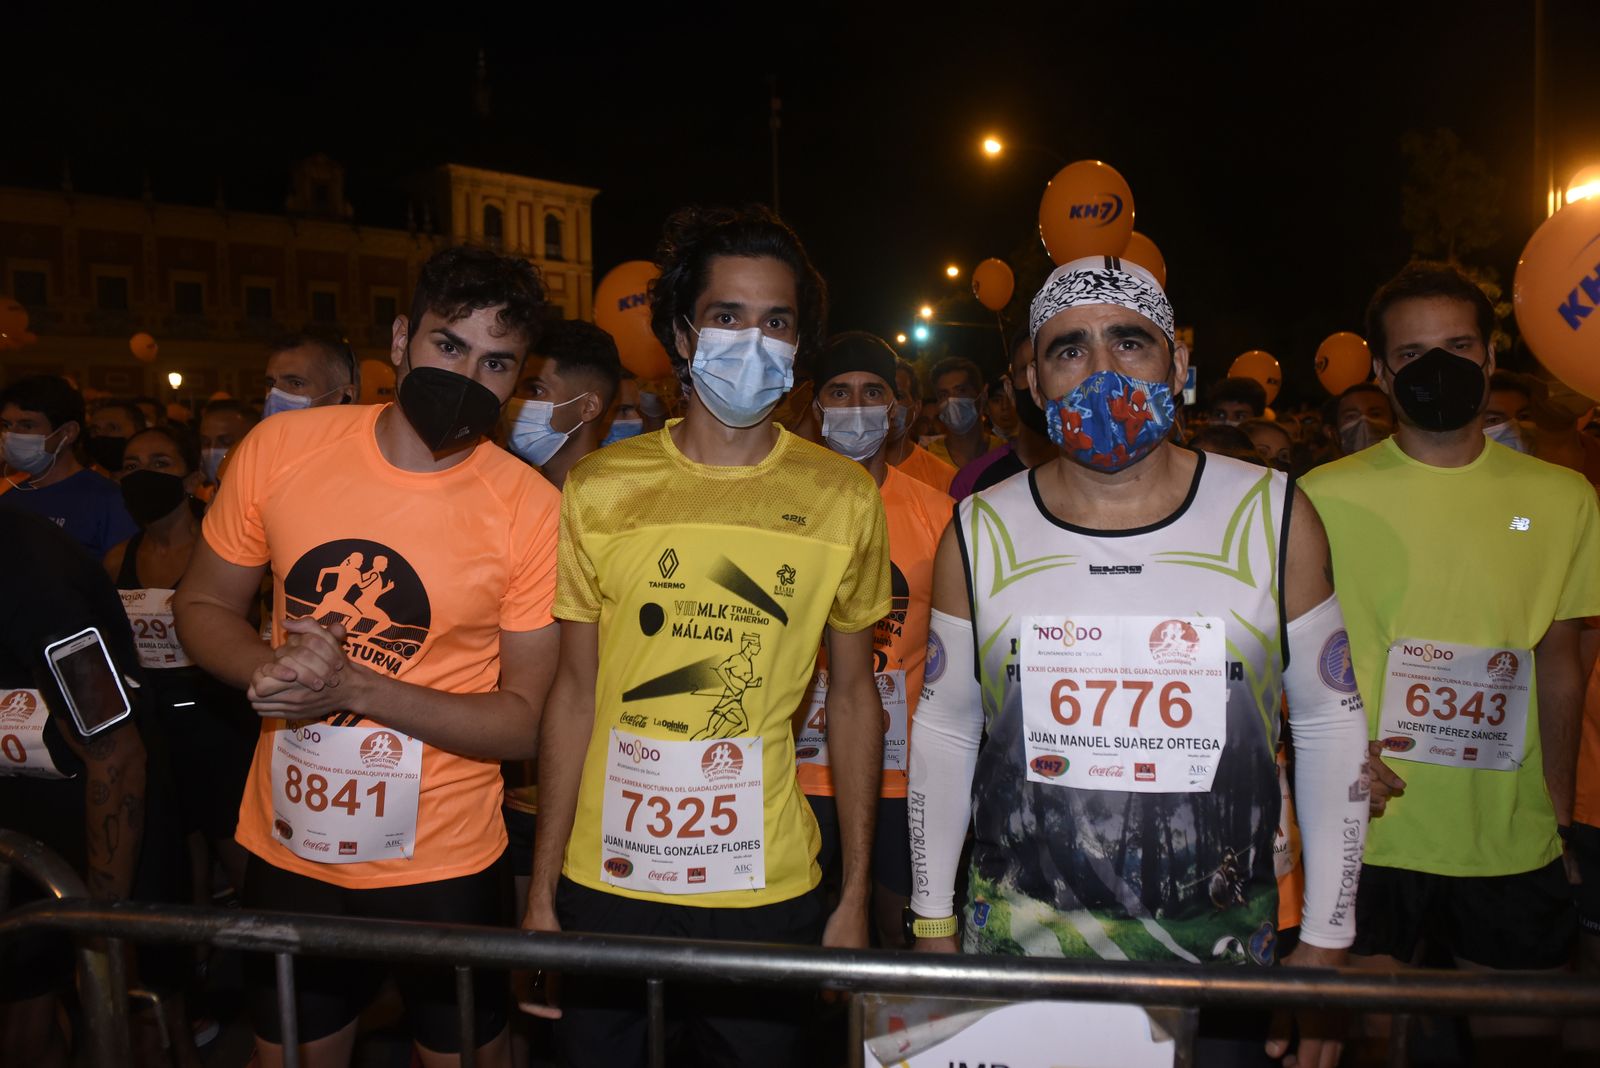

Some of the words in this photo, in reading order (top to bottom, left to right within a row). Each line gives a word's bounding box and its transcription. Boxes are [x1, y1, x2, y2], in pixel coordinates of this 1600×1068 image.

[649, 581, 685, 589] TAHERMO
[697, 602, 729, 619] MLK
[731, 605, 755, 615] TRAIL
[730, 613, 770, 626] TAHERMO
[672, 618, 733, 643] MÁLAGA
[1134, 668, 1188, 676] GUADALQUIVIR
[1050, 678, 1192, 729] 6776
[1405, 683, 1507, 726] 6343
[1028, 731, 1057, 744] JUAN
[1060, 735, 1110, 748] MANUEL
[1114, 737, 1163, 750] SUAREZ
[1167, 738, 1220, 750] ORTEGA
[1397, 720, 1436, 734] VICENTE
[1439, 723, 1470, 738] PÉREZ
[1472, 727, 1508, 741] SÁNCHEZ
[285, 764, 386, 817] 8841
[621, 778, 642, 788] CARRERA
[642, 783, 674, 793] NOCTURNA
[687, 783, 734, 793] GUADALQUIVIR
[622, 789, 738, 839] 7325
[603, 834, 624, 847] JUAN
[625, 840, 664, 856] MANUEL
[664, 843, 718, 857] GONZÁLEZ
[721, 840, 761, 853] FLORES
